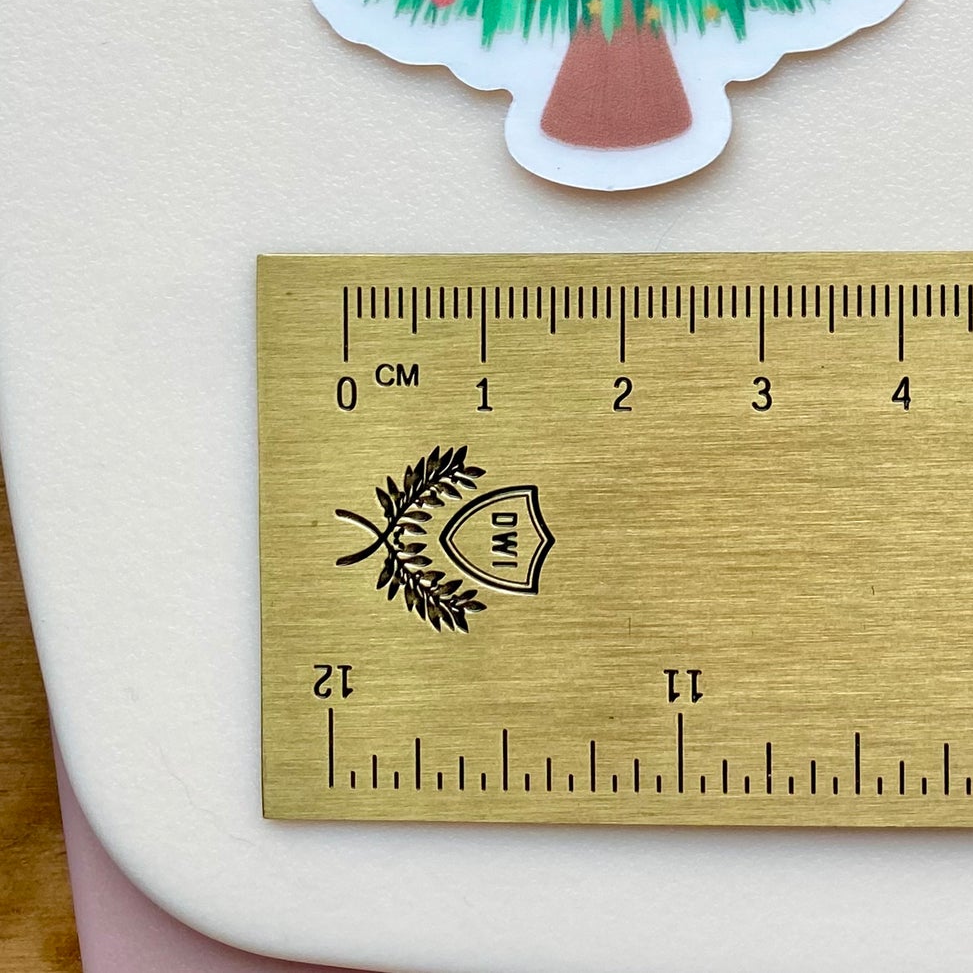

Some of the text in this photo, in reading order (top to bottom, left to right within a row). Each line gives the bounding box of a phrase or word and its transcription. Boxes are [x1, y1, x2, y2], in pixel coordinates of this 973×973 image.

[375, 363, 419, 387] CM
[336, 376, 358, 411] 0
[475, 377, 493, 412] 1
[613, 376, 633, 412] 2
[751, 376, 773, 412] 3
[891, 376, 912, 411] 4
[491, 512, 518, 568] DWI
[313, 664, 354, 699] 12
[663, 669, 704, 703] 11
